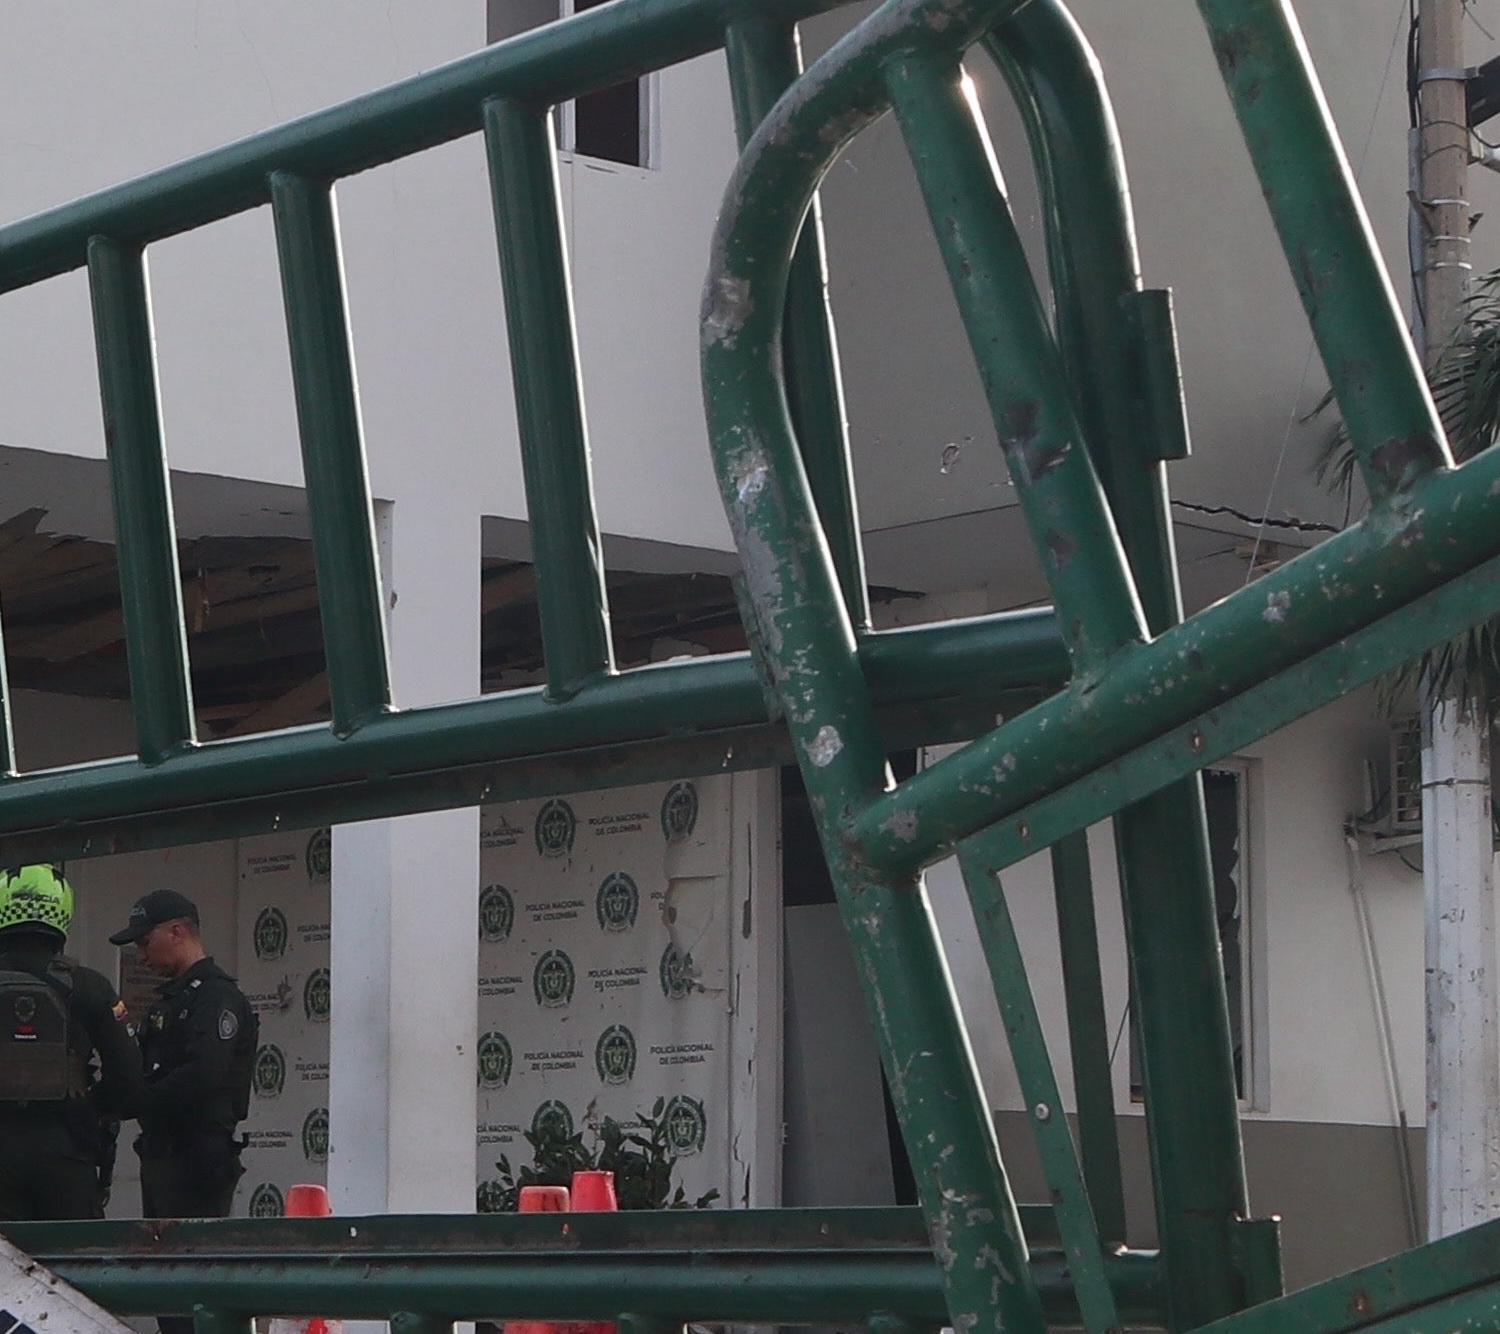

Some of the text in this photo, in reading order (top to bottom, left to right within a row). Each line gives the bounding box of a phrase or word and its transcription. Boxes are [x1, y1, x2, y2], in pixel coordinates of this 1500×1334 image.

[606, 824, 642, 834] COLOMBIA
[552, 899, 585, 909] NACIONAL
[543, 910, 578, 920] COLOMBIA
[615, 965, 648, 976] NACIONAL
[605, 977, 640, 988] COLOMBIA
[551, 1049, 584, 1059] NACIONAL
[541, 1061, 576, 1071] COLOMBIA
